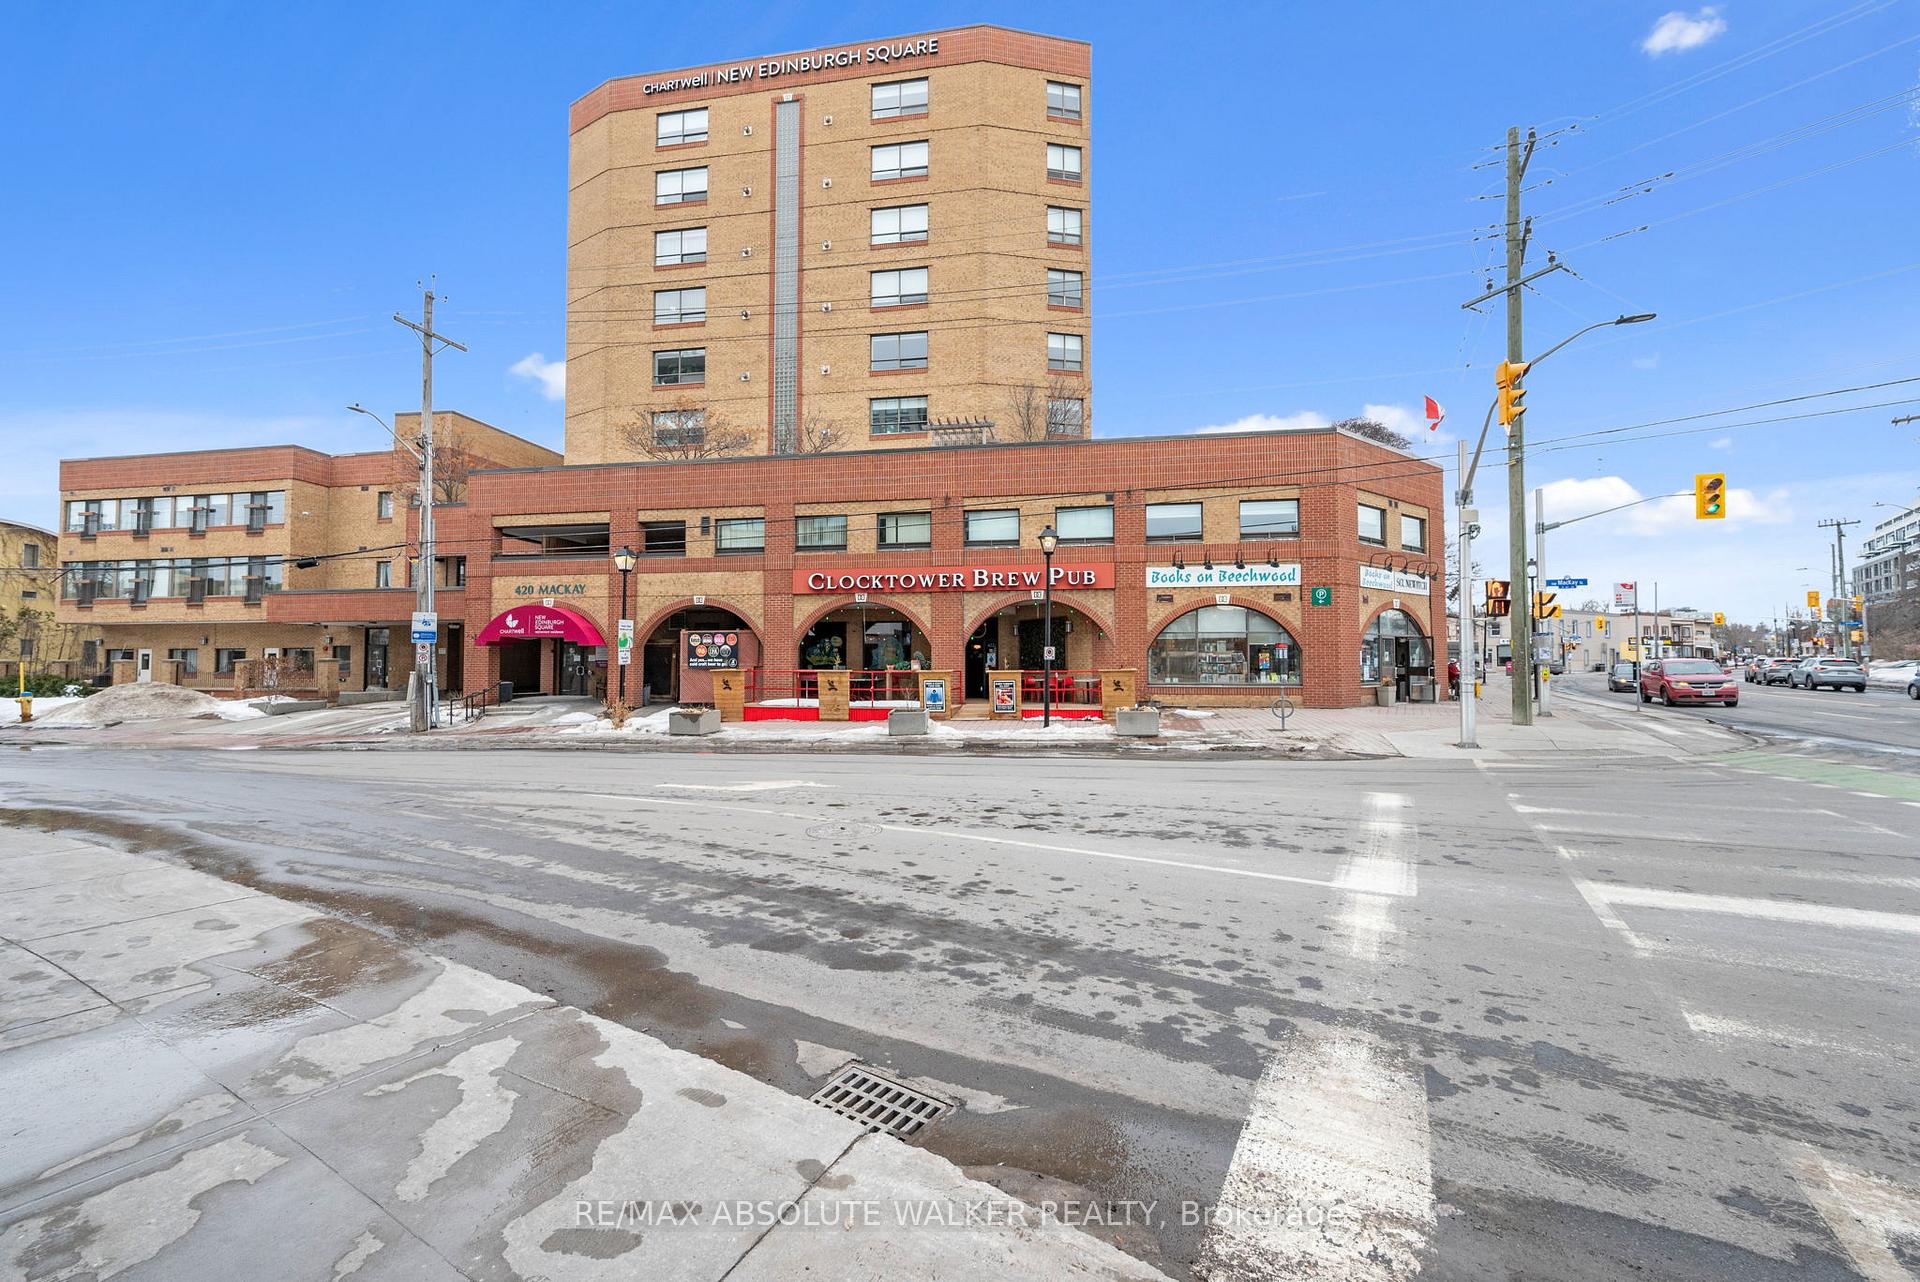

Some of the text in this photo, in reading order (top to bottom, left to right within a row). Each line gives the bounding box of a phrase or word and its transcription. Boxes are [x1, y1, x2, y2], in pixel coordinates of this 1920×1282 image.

[717, 64, 754, 84] NEW
[759, 49, 861, 77] EDINBURGH
[866, 38, 939, 62] SQUARE
[808, 567, 1096, 590] CLOCKTOWER BREW PUB
[1151, 567, 1296, 583] Books on Beechwood
[515, 584, 586, 595] 420 MACKAY
